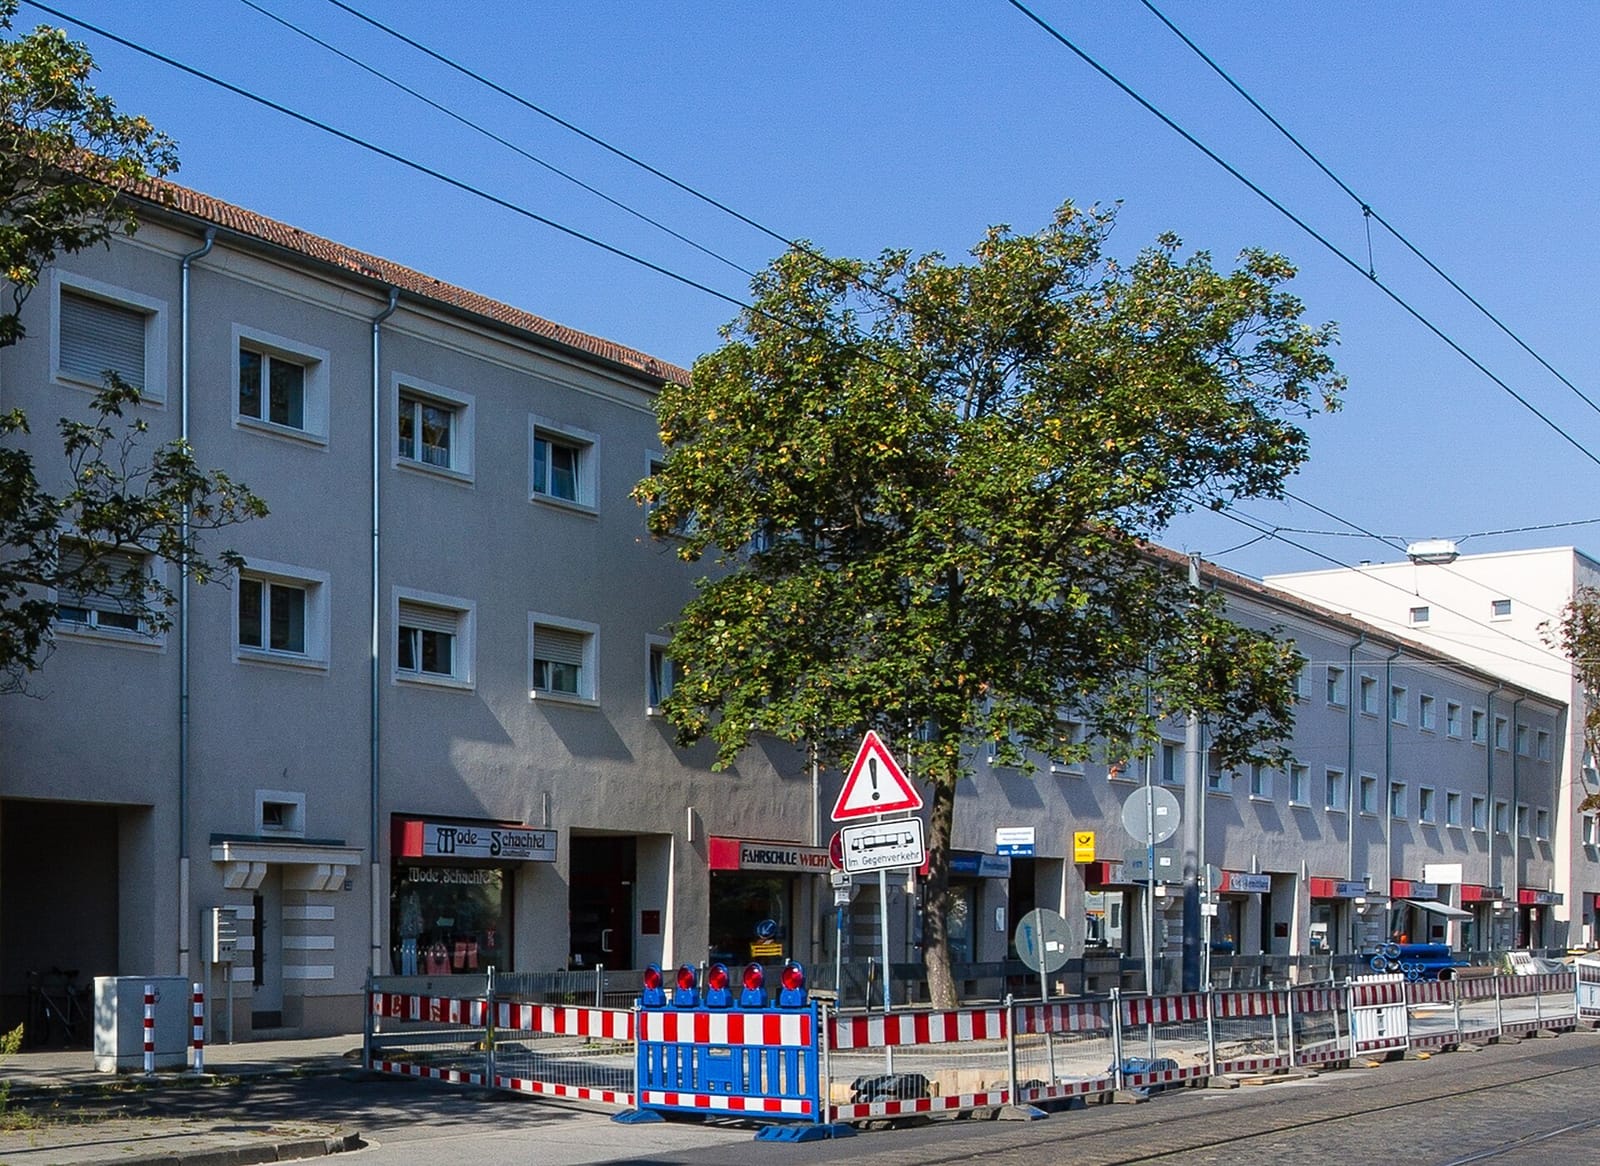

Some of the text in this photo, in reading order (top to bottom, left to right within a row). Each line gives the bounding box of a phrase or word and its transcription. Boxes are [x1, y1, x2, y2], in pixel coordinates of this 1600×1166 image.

[437, 827, 545, 856] Mode Schachtel
[742, 849, 829, 868] FAHRSCHULE WICHT
[862, 851, 920, 866] Gegenverkehr
